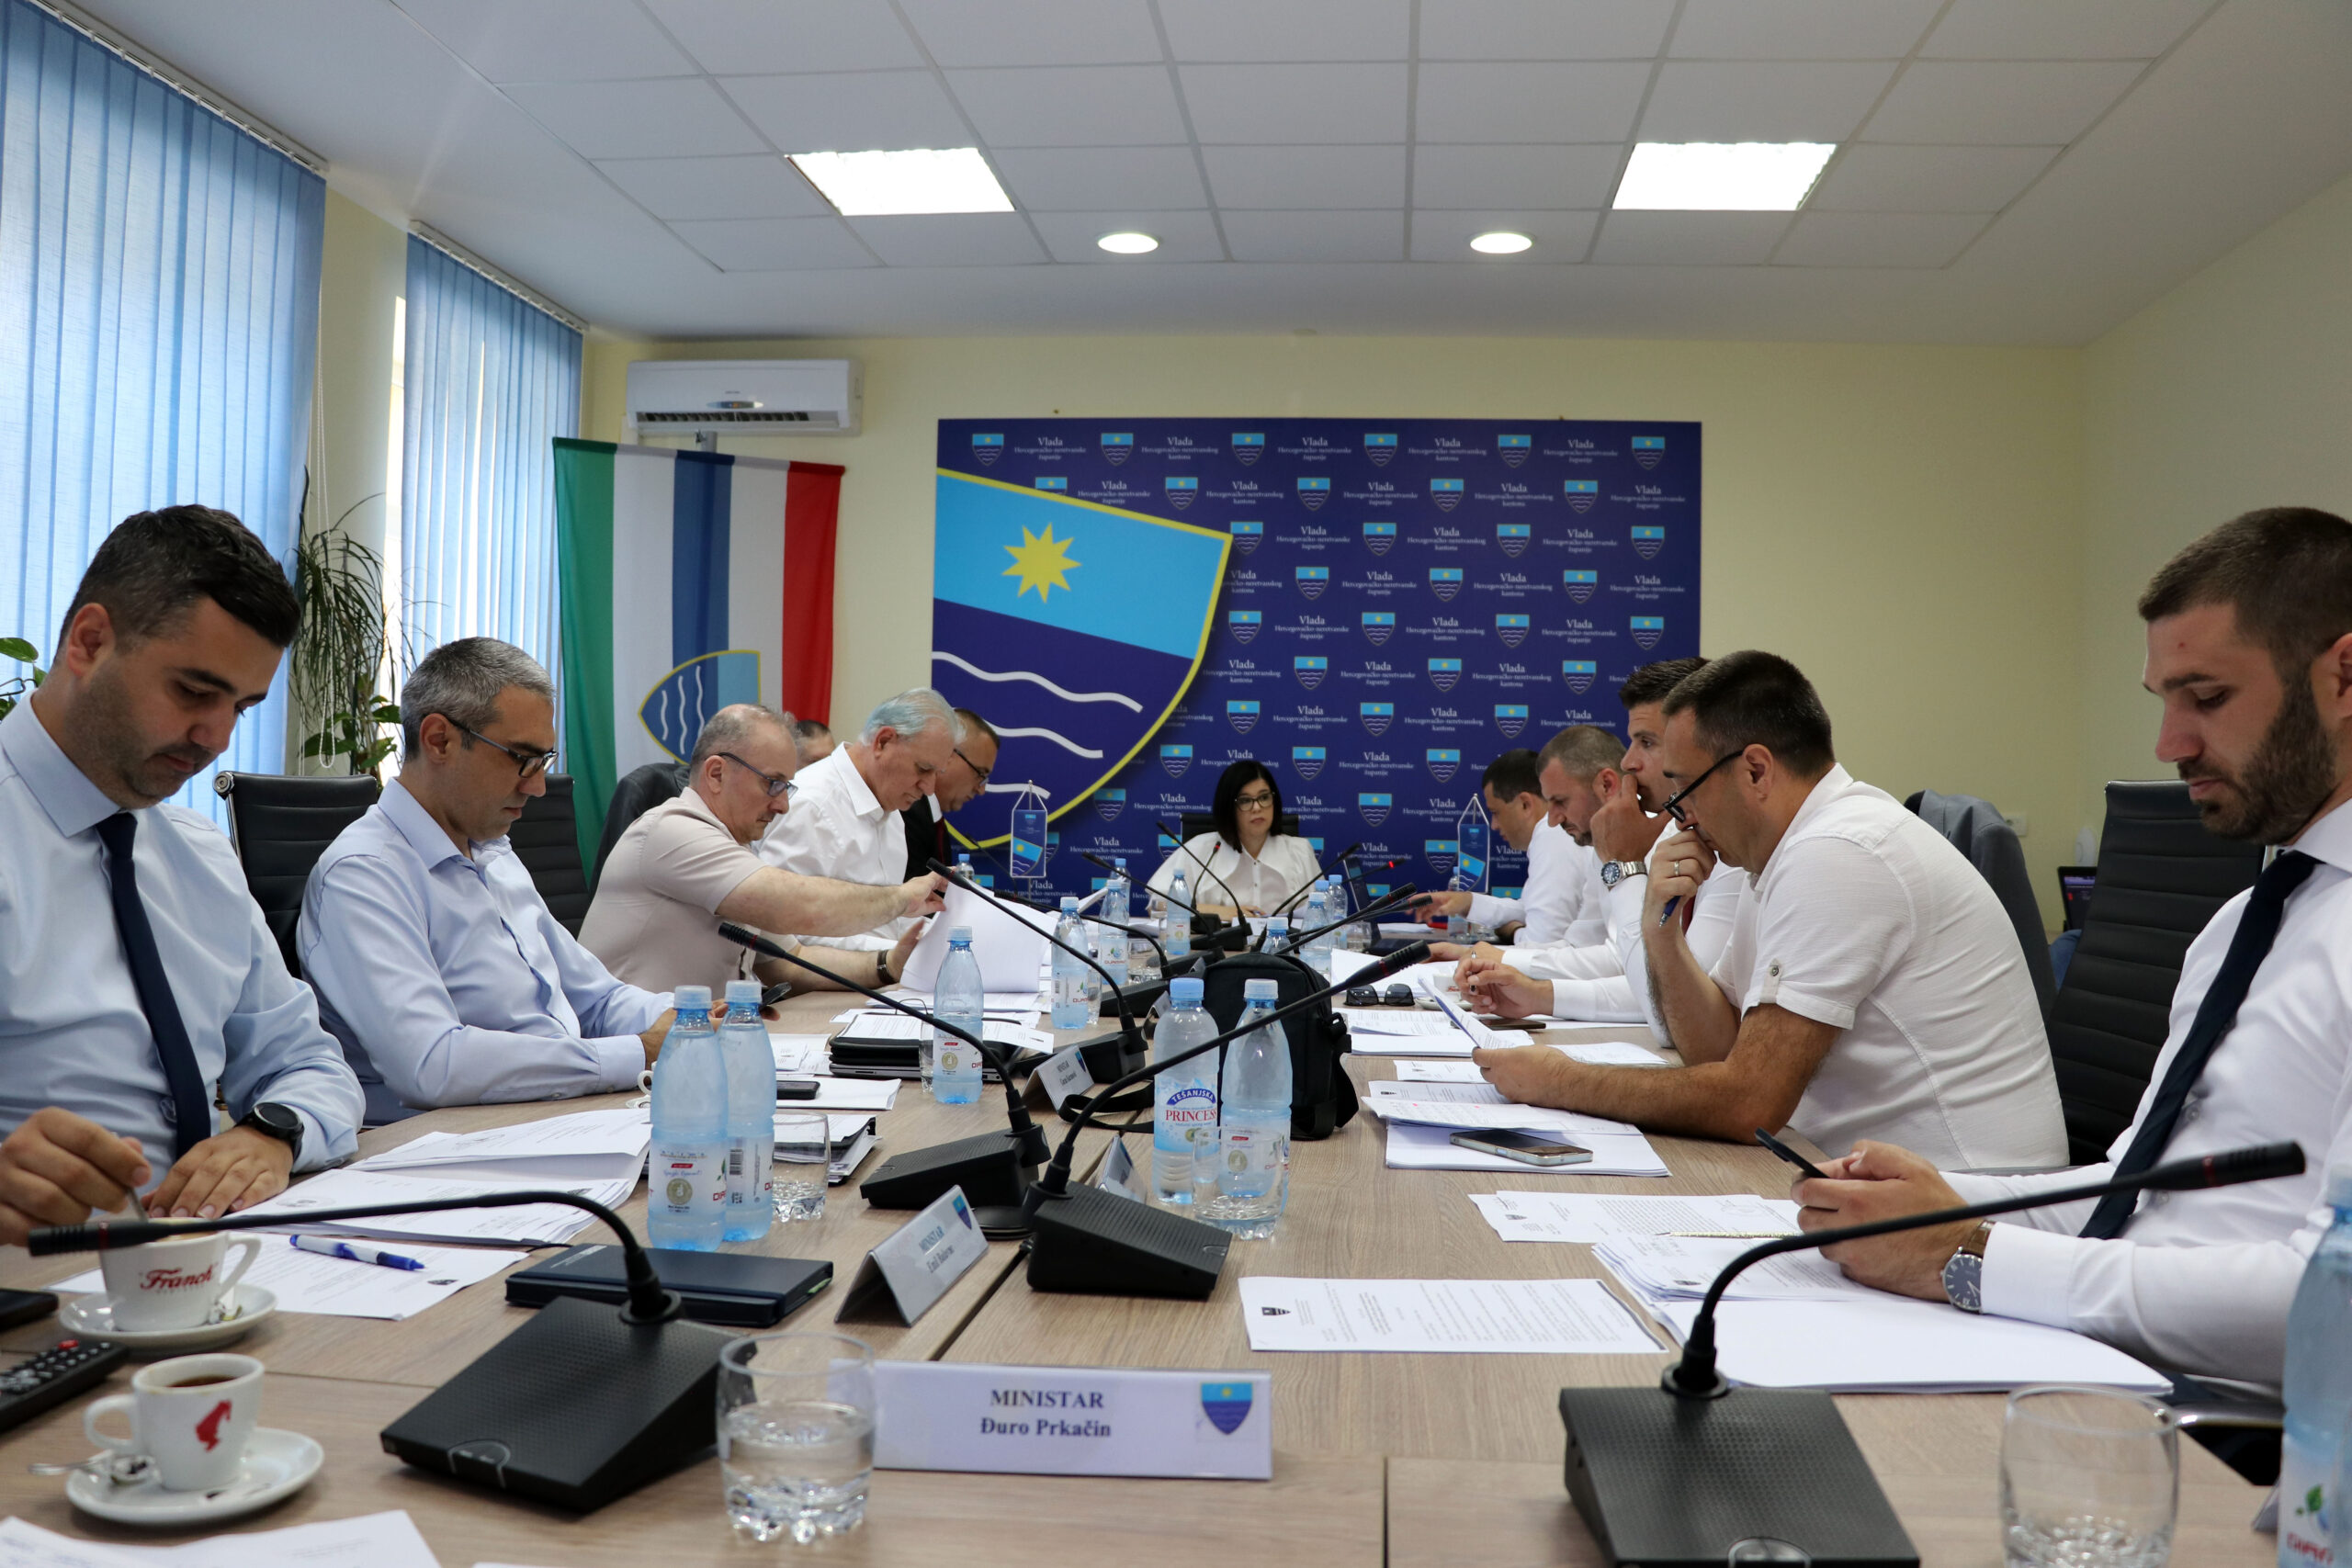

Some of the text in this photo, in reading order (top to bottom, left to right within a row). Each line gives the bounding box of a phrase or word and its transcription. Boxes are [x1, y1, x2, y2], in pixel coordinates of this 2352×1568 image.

[1037, 437, 1064, 446] Vlada
[1166, 437, 1193, 446] Vlada
[1301, 437, 1329, 446] Vlada
[1434, 438, 1461, 447] Vlada
[1567, 439, 1594, 448] Vlada
[1101, 480, 1127, 490] Vlada
[1231, 481, 1259, 491] Vlada
[1367, 482, 1395, 491] Vlada
[1500, 483, 1528, 492] Vlada
[1634, 485, 1662, 494] Vlada
[1300, 526, 1328, 536] Vlada
[1433, 527, 1460, 536] Vlada
[1566, 529, 1594, 537] Vlada
[1230, 570, 1257, 580] Vlada
[1366, 571, 1393, 581] Vlada
[1499, 573, 1527, 582] Vlada
[1634, 575, 1661, 584] Vlada
[1298, 615, 1326, 625] Vlada
[1431, 617, 1459, 626] Vlada
[1566, 619, 1593, 628] Vlada
[1228, 660, 1255, 669] Vlada
[1364, 661, 1392, 671] Vlada
[1498, 663, 1526, 672] Vlada
[1296, 706, 1324, 715] Vlada
[1430, 707, 1458, 716] Vlada
[1565, 710, 1592, 719] Vlada
[1227, 750, 1254, 759] Vlada
[1363, 752, 1391, 761] Vlada
[1159, 793, 1187, 803] Vlada
[1295, 795, 1322, 806] Vlada
[1429, 798, 1456, 807] Vlada
[1093, 836, 1120, 846] Vlada
[1361, 842, 1389, 852] Vlada
[990, 1389, 1104, 1408] MINISTAR
[980, 1416, 1112, 1438] Đuro Prkačin
